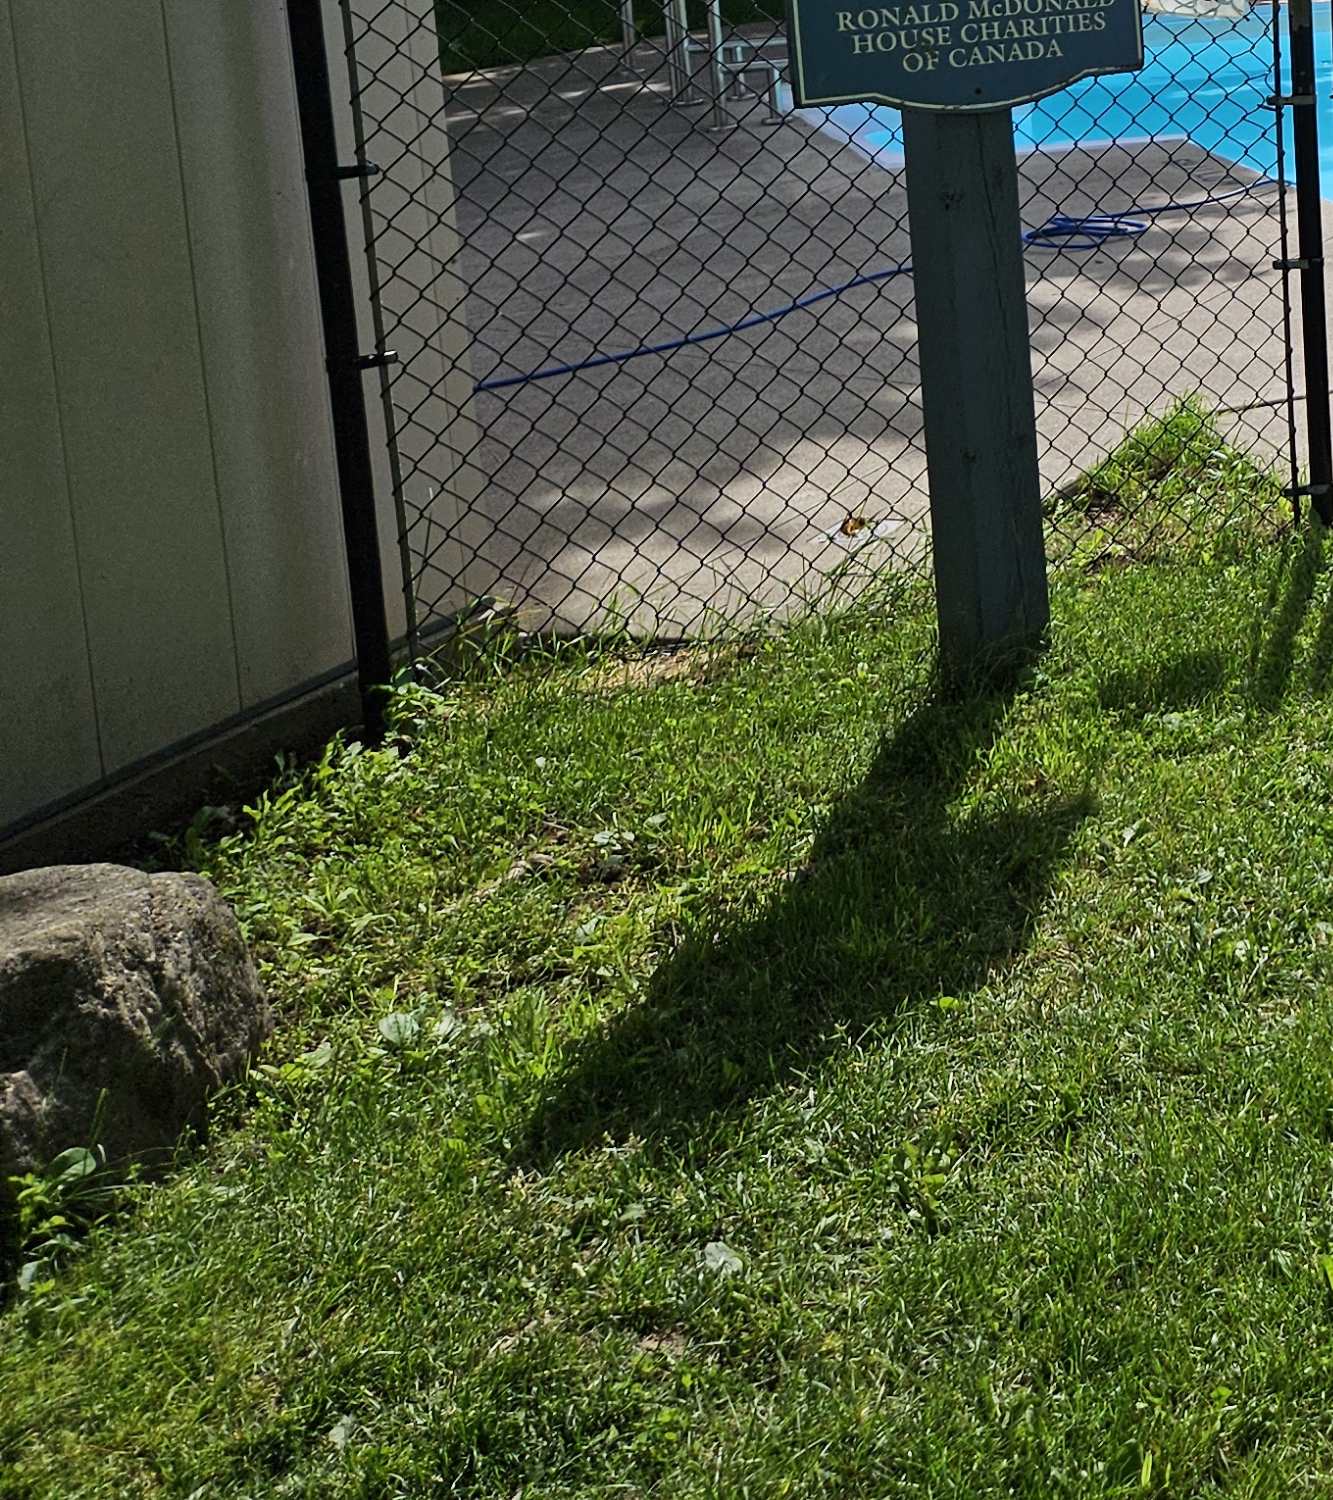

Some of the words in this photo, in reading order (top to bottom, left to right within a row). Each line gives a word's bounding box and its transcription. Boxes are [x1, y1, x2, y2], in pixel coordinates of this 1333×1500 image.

[836, 1, 959, 32] RONALD
[852, 26, 951, 54] HOUSE
[960, 12, 1105, 42] CHARITIES
[902, 51, 939, 72] OF
[949, 39, 1063, 68] CANADA
